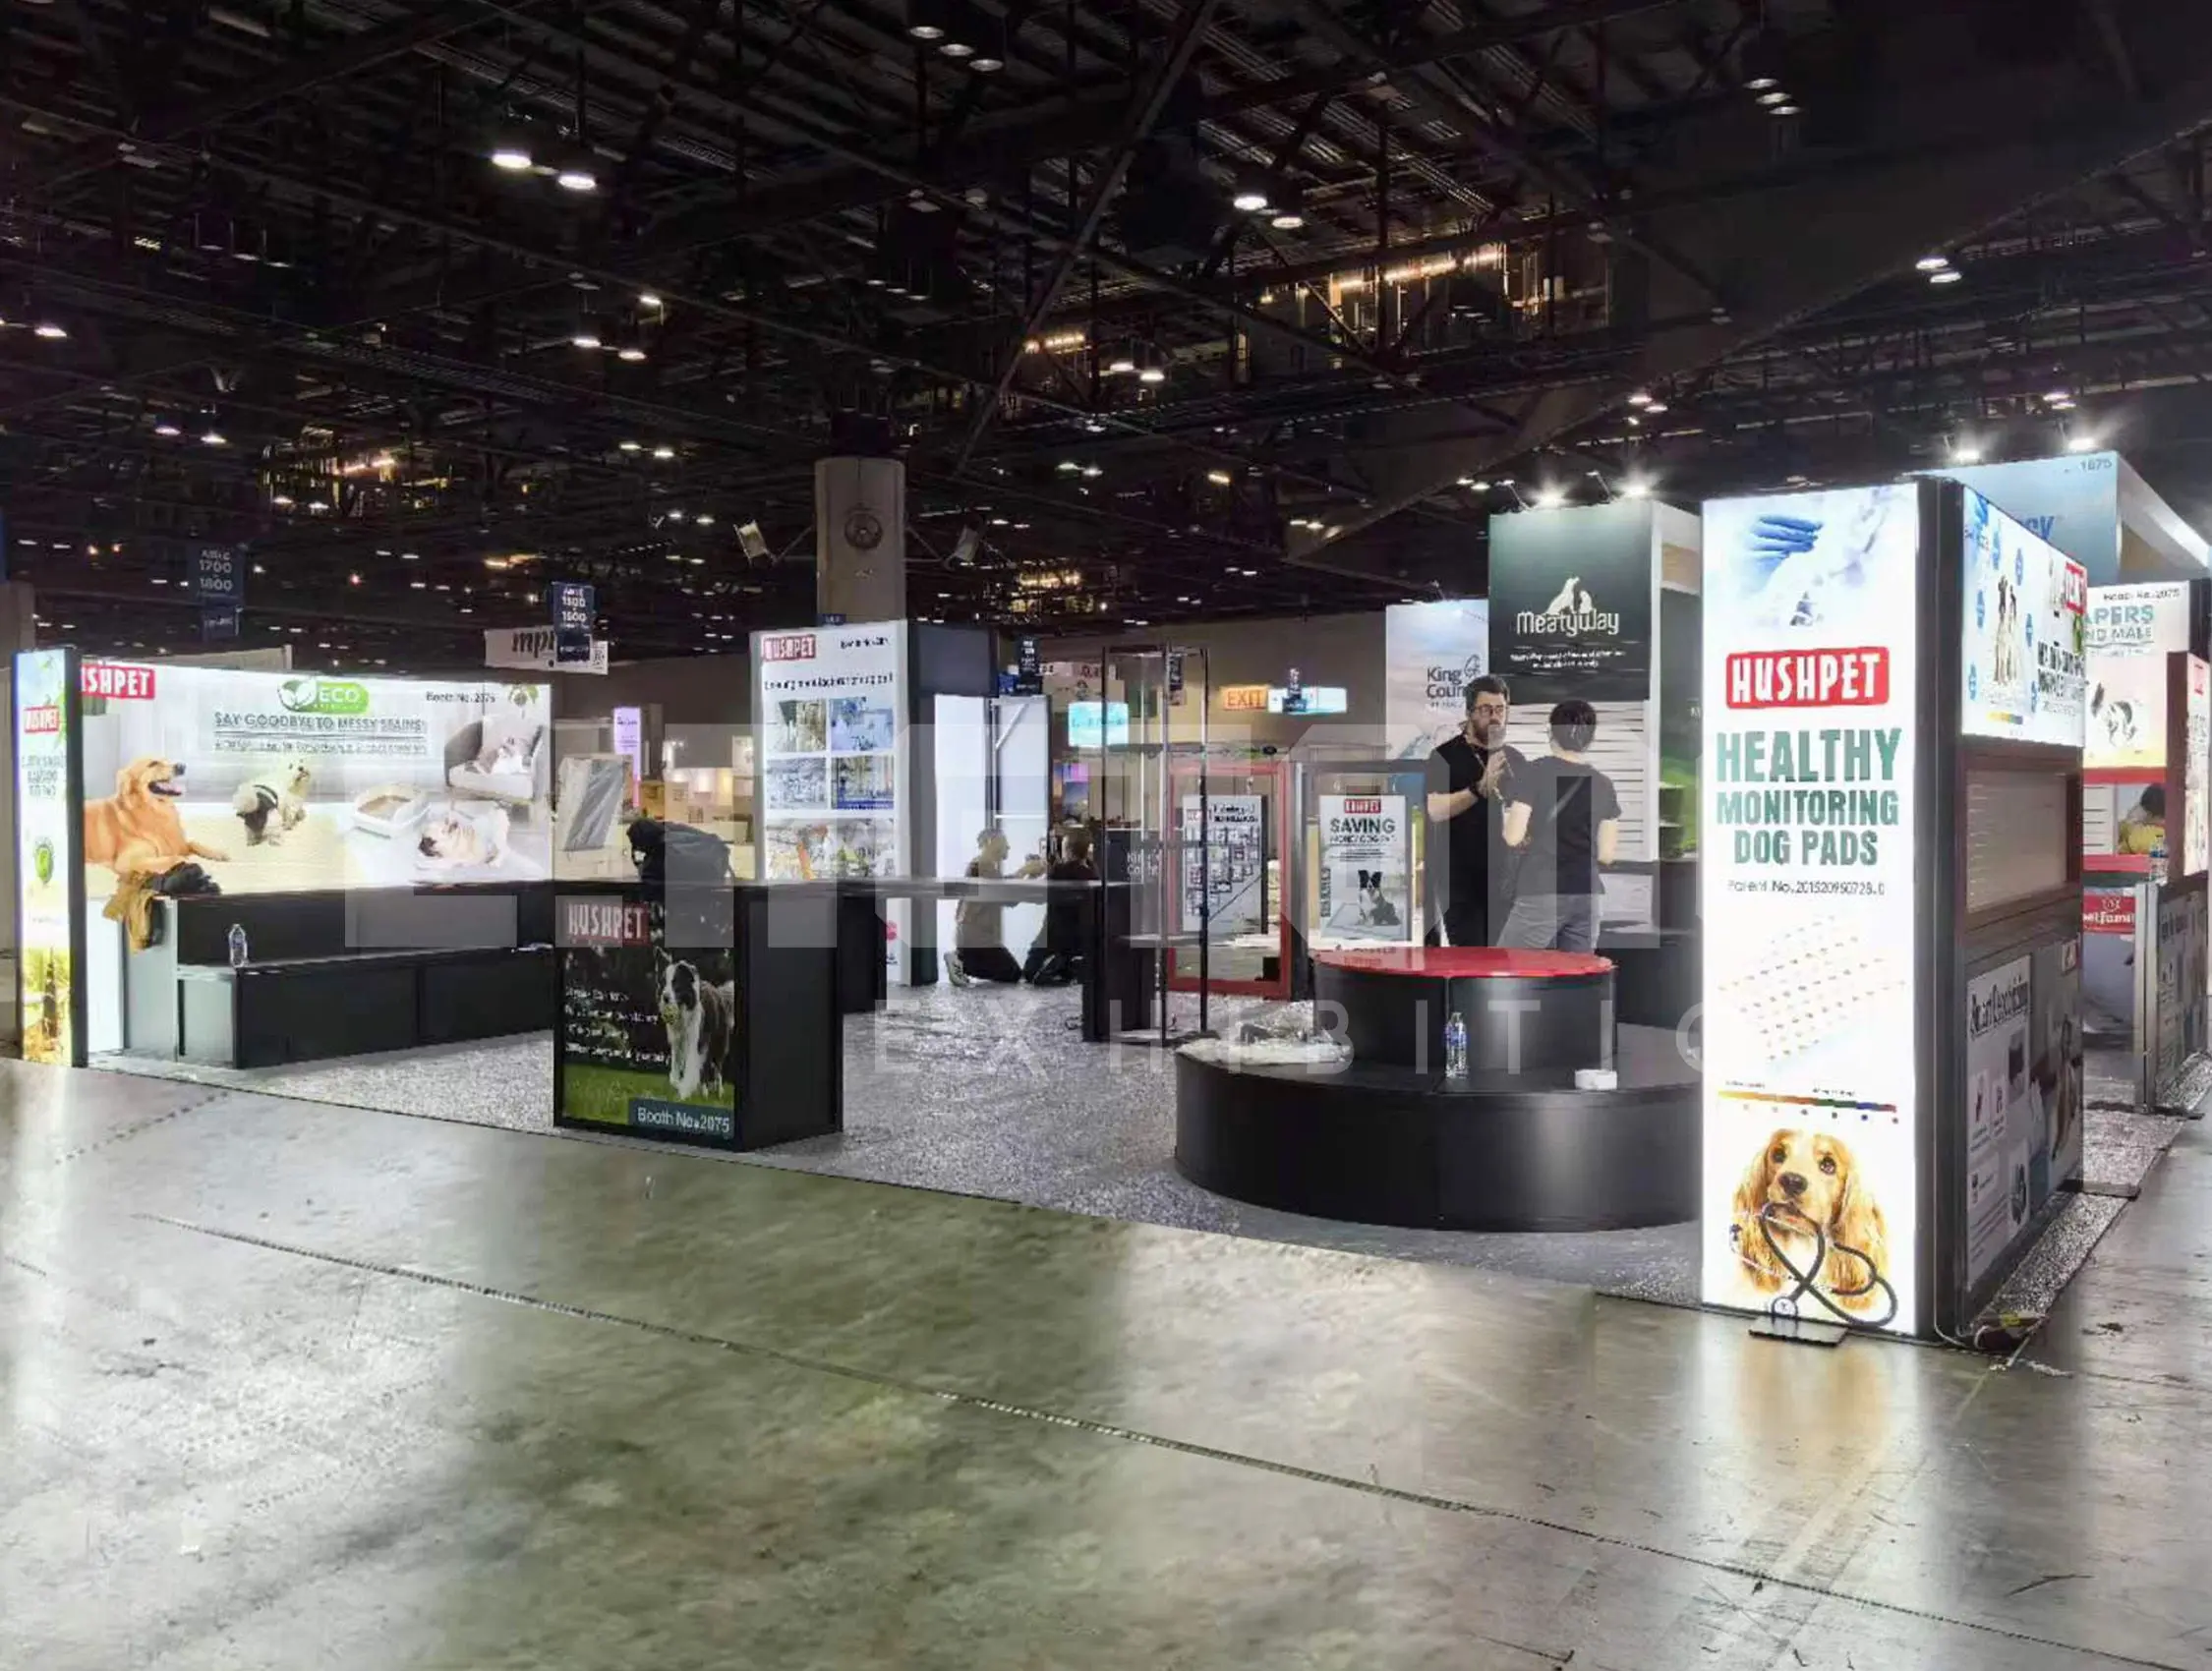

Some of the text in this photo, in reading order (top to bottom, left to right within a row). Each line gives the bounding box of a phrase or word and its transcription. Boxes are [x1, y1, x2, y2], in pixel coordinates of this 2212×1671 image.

[199, 559, 232, 573] 1700
[1426, 666, 1463, 686] King
[1732, 653, 1880, 704] HUSHPET
[320, 688, 360, 703] ECO
[1228, 690, 1263, 707] EXIT
[1426, 684, 1469, 699] Coun
[214, 712, 242, 727] SAY
[244, 714, 314, 728] GOODBYE
[314, 717, 334, 729] TO
[337, 718, 378, 732] MESSY
[1717, 728, 1902, 782] HEALTHY
[1717, 790, 1899, 826] MONITORING
[1330, 818, 1395, 834] SAVING
[1734, 830, 1879, 866] DOG PADS
[568, 904, 644, 939] HUSHPET
[637, 1107, 673, 1124] Booth
